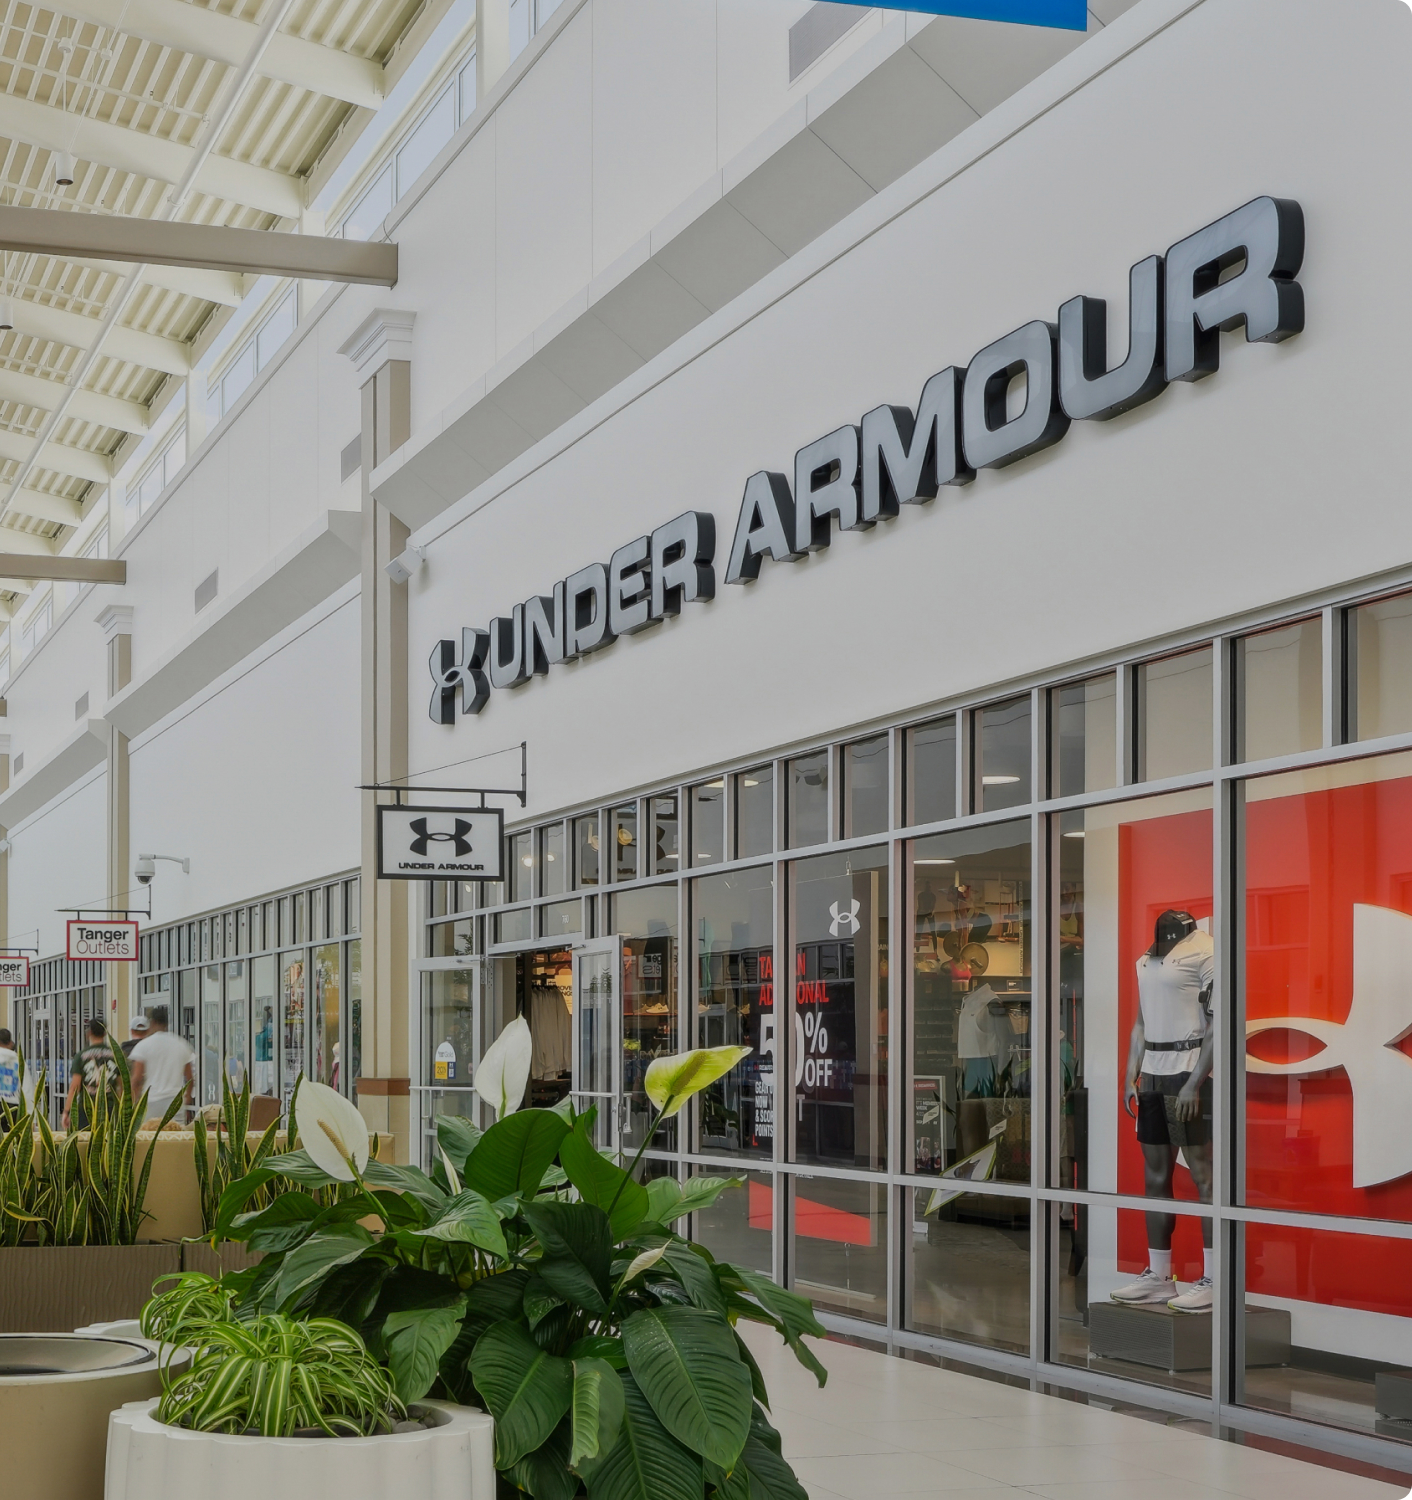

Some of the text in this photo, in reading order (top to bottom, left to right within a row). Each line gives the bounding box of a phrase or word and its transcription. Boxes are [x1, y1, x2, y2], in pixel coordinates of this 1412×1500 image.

[489, 195, 1305, 689] UNDER ARMOUR
[398, 862, 484, 871] UNDER ARMOUR
[77, 928, 129, 943] Tanger
[76, 940, 129, 955] Outlets
[759, 980, 829, 1006] ADONAL
[805, 1058, 833, 1087] OFF
[755, 1109, 760, 1122] &
